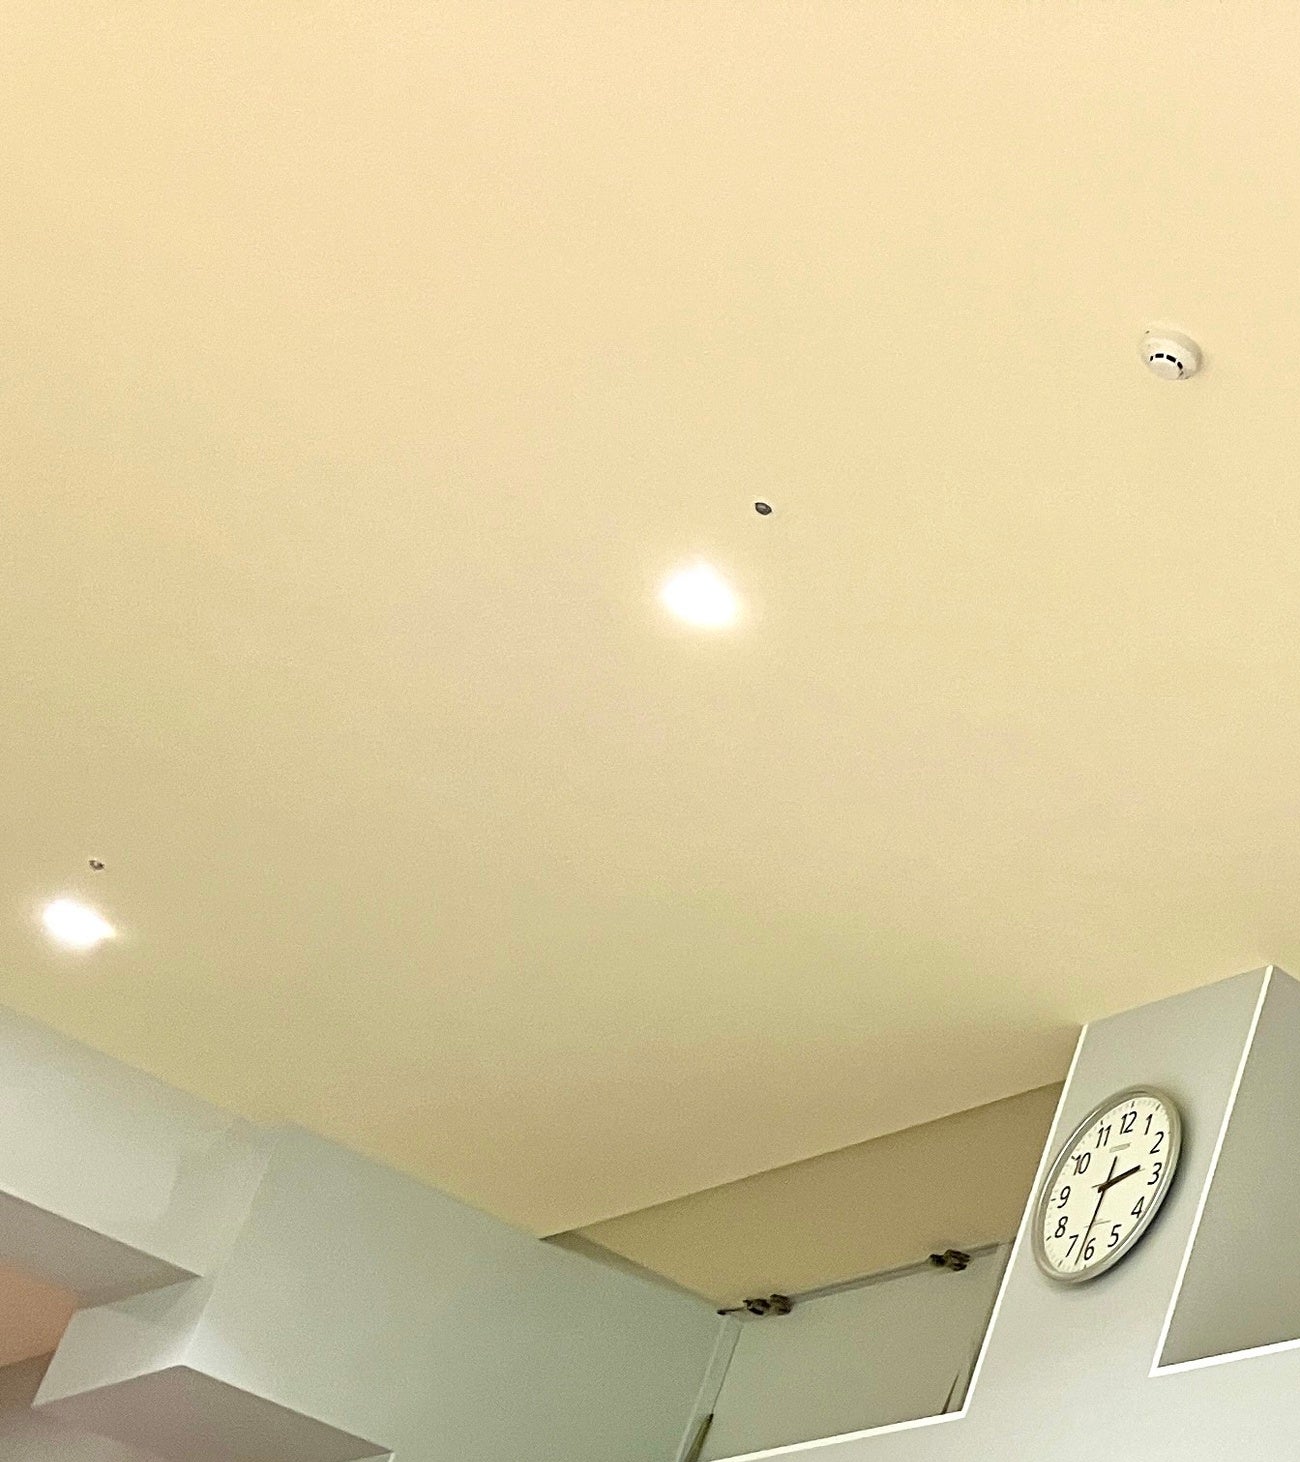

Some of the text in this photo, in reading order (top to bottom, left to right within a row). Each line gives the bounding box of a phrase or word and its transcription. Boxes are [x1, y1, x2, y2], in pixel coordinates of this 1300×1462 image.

[1119, 1111, 1138, 1135] 12
[1144, 1114, 1153, 1135] 1
[1095, 1125, 1112, 1149] 11
[1150, 1131, 1164, 1155] 2
[1073, 1152, 1091, 1176] 10
[1147, 1162, 1163, 1186] 3
[1057, 1186, 1071, 1209] 9
[1131, 1196, 1145, 1219] 4
[1054, 1216, 1069, 1239] 8
[1107, 1224, 1122, 1248] 5
[1065, 1234, 1079, 1258] 7
[1084, 1238, 1096, 1261] 6
